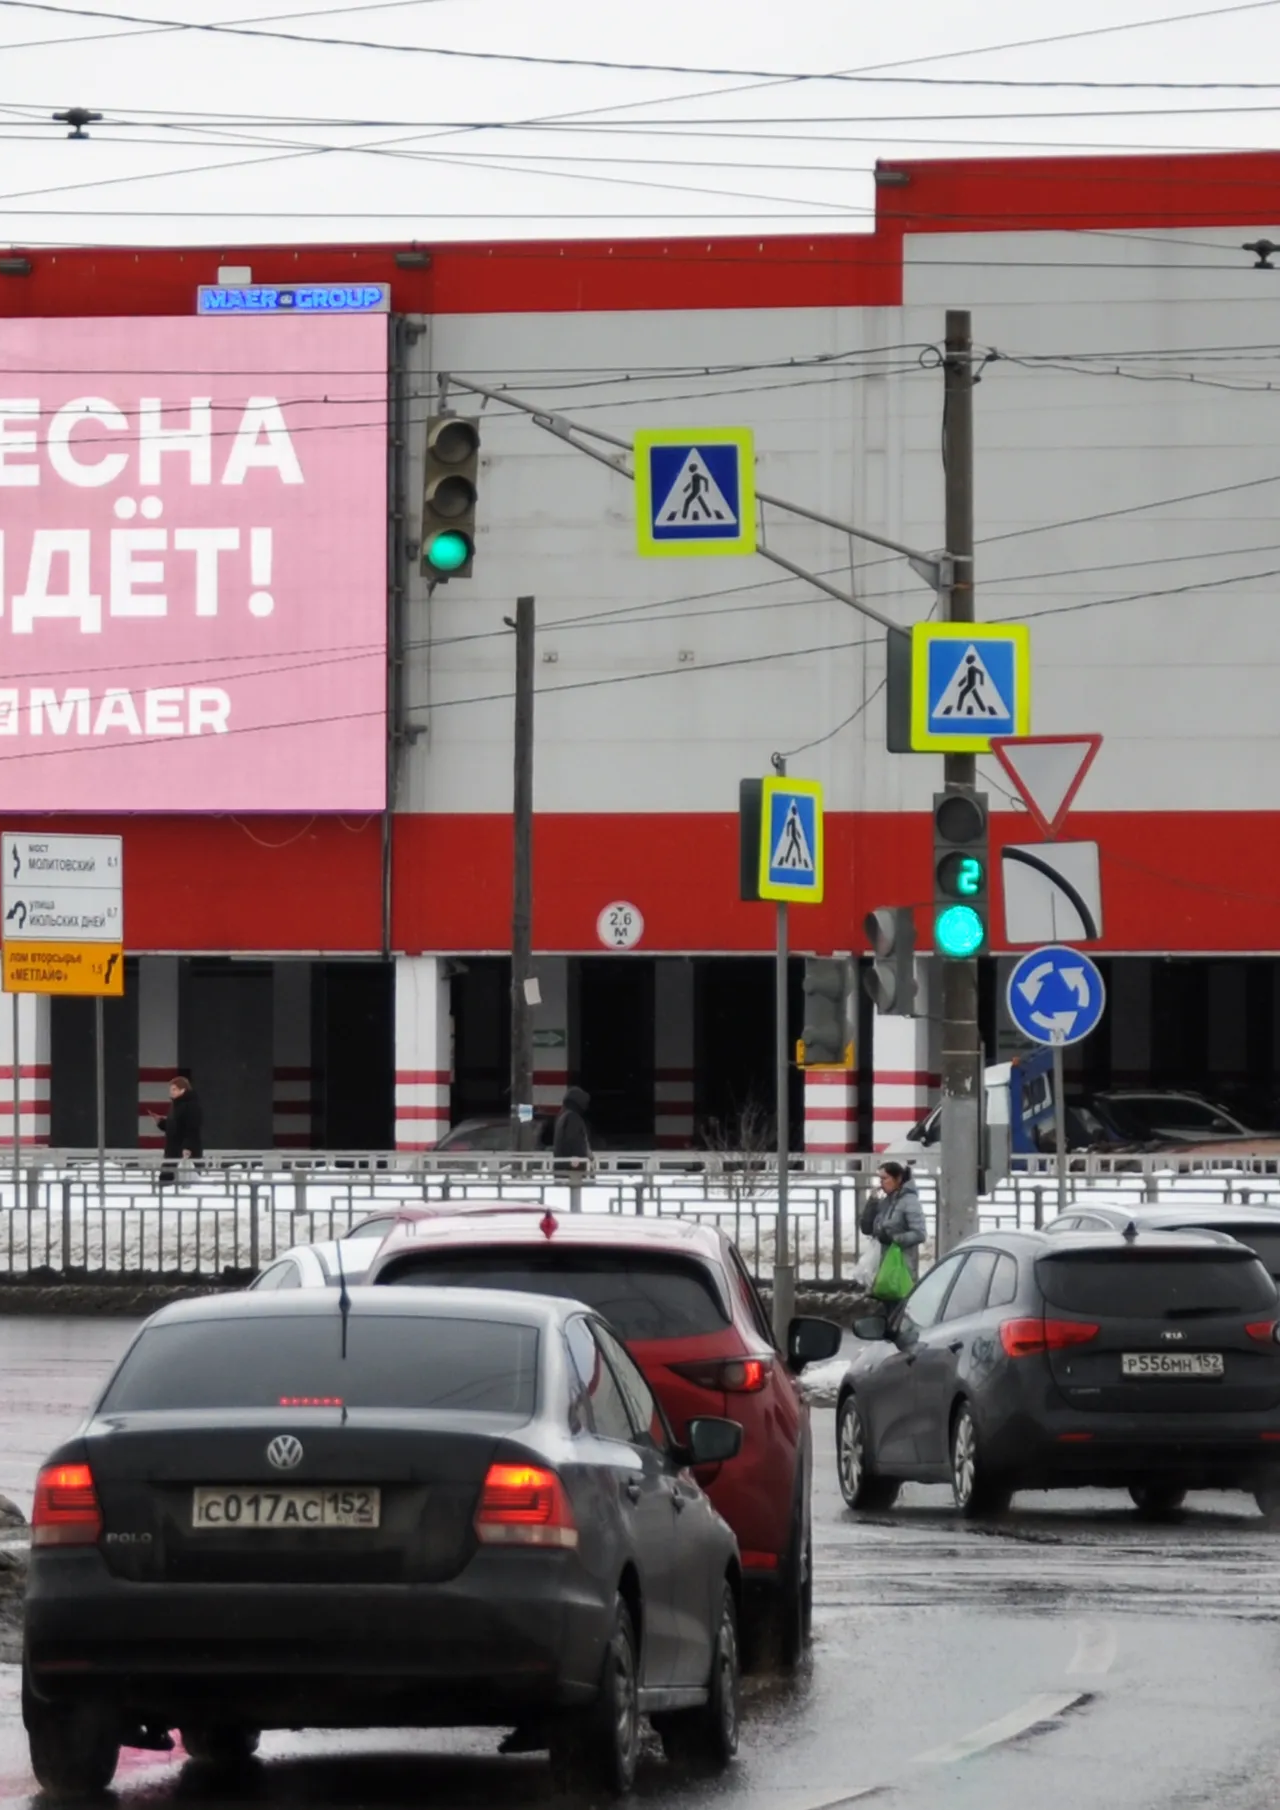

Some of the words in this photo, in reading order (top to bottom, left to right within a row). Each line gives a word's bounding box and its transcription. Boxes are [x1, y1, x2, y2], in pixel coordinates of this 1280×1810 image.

[203, 289, 279, 309] MAER
[295, 288, 382, 308] GROUP
[29, 686, 232, 736] MAER
[959, 858, 980, 894] 2
[1196, 1354, 1221, 1368] 152
[204, 1494, 319, 1523] С017АС
[328, 1492, 370, 1515] 152
[106, 1532, 153, 1544] POLO
